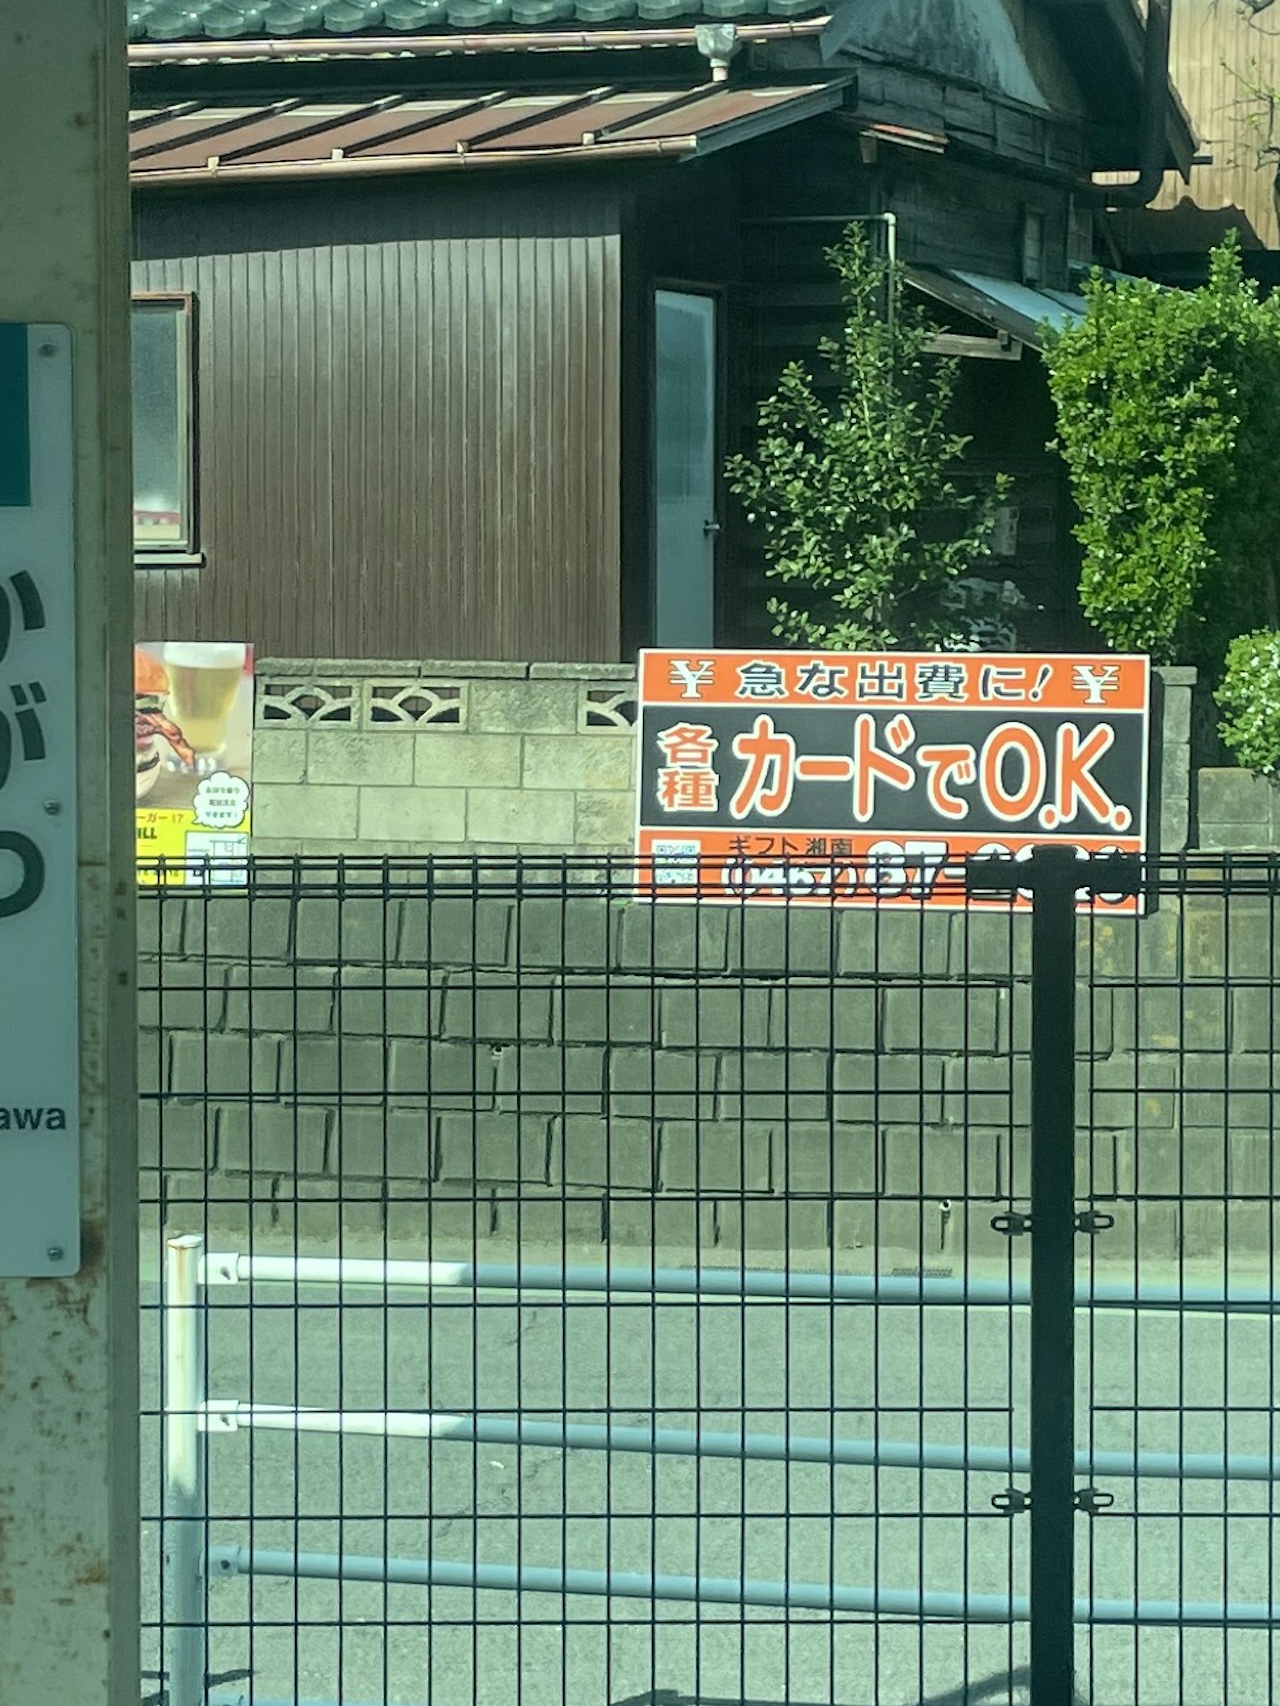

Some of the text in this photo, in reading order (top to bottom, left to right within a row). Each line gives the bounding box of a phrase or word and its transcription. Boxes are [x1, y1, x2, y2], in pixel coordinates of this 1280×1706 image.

[736, 661, 1054, 703] 急な出費に!
[656, 712, 1133, 831] 各種 カードでO.K.
